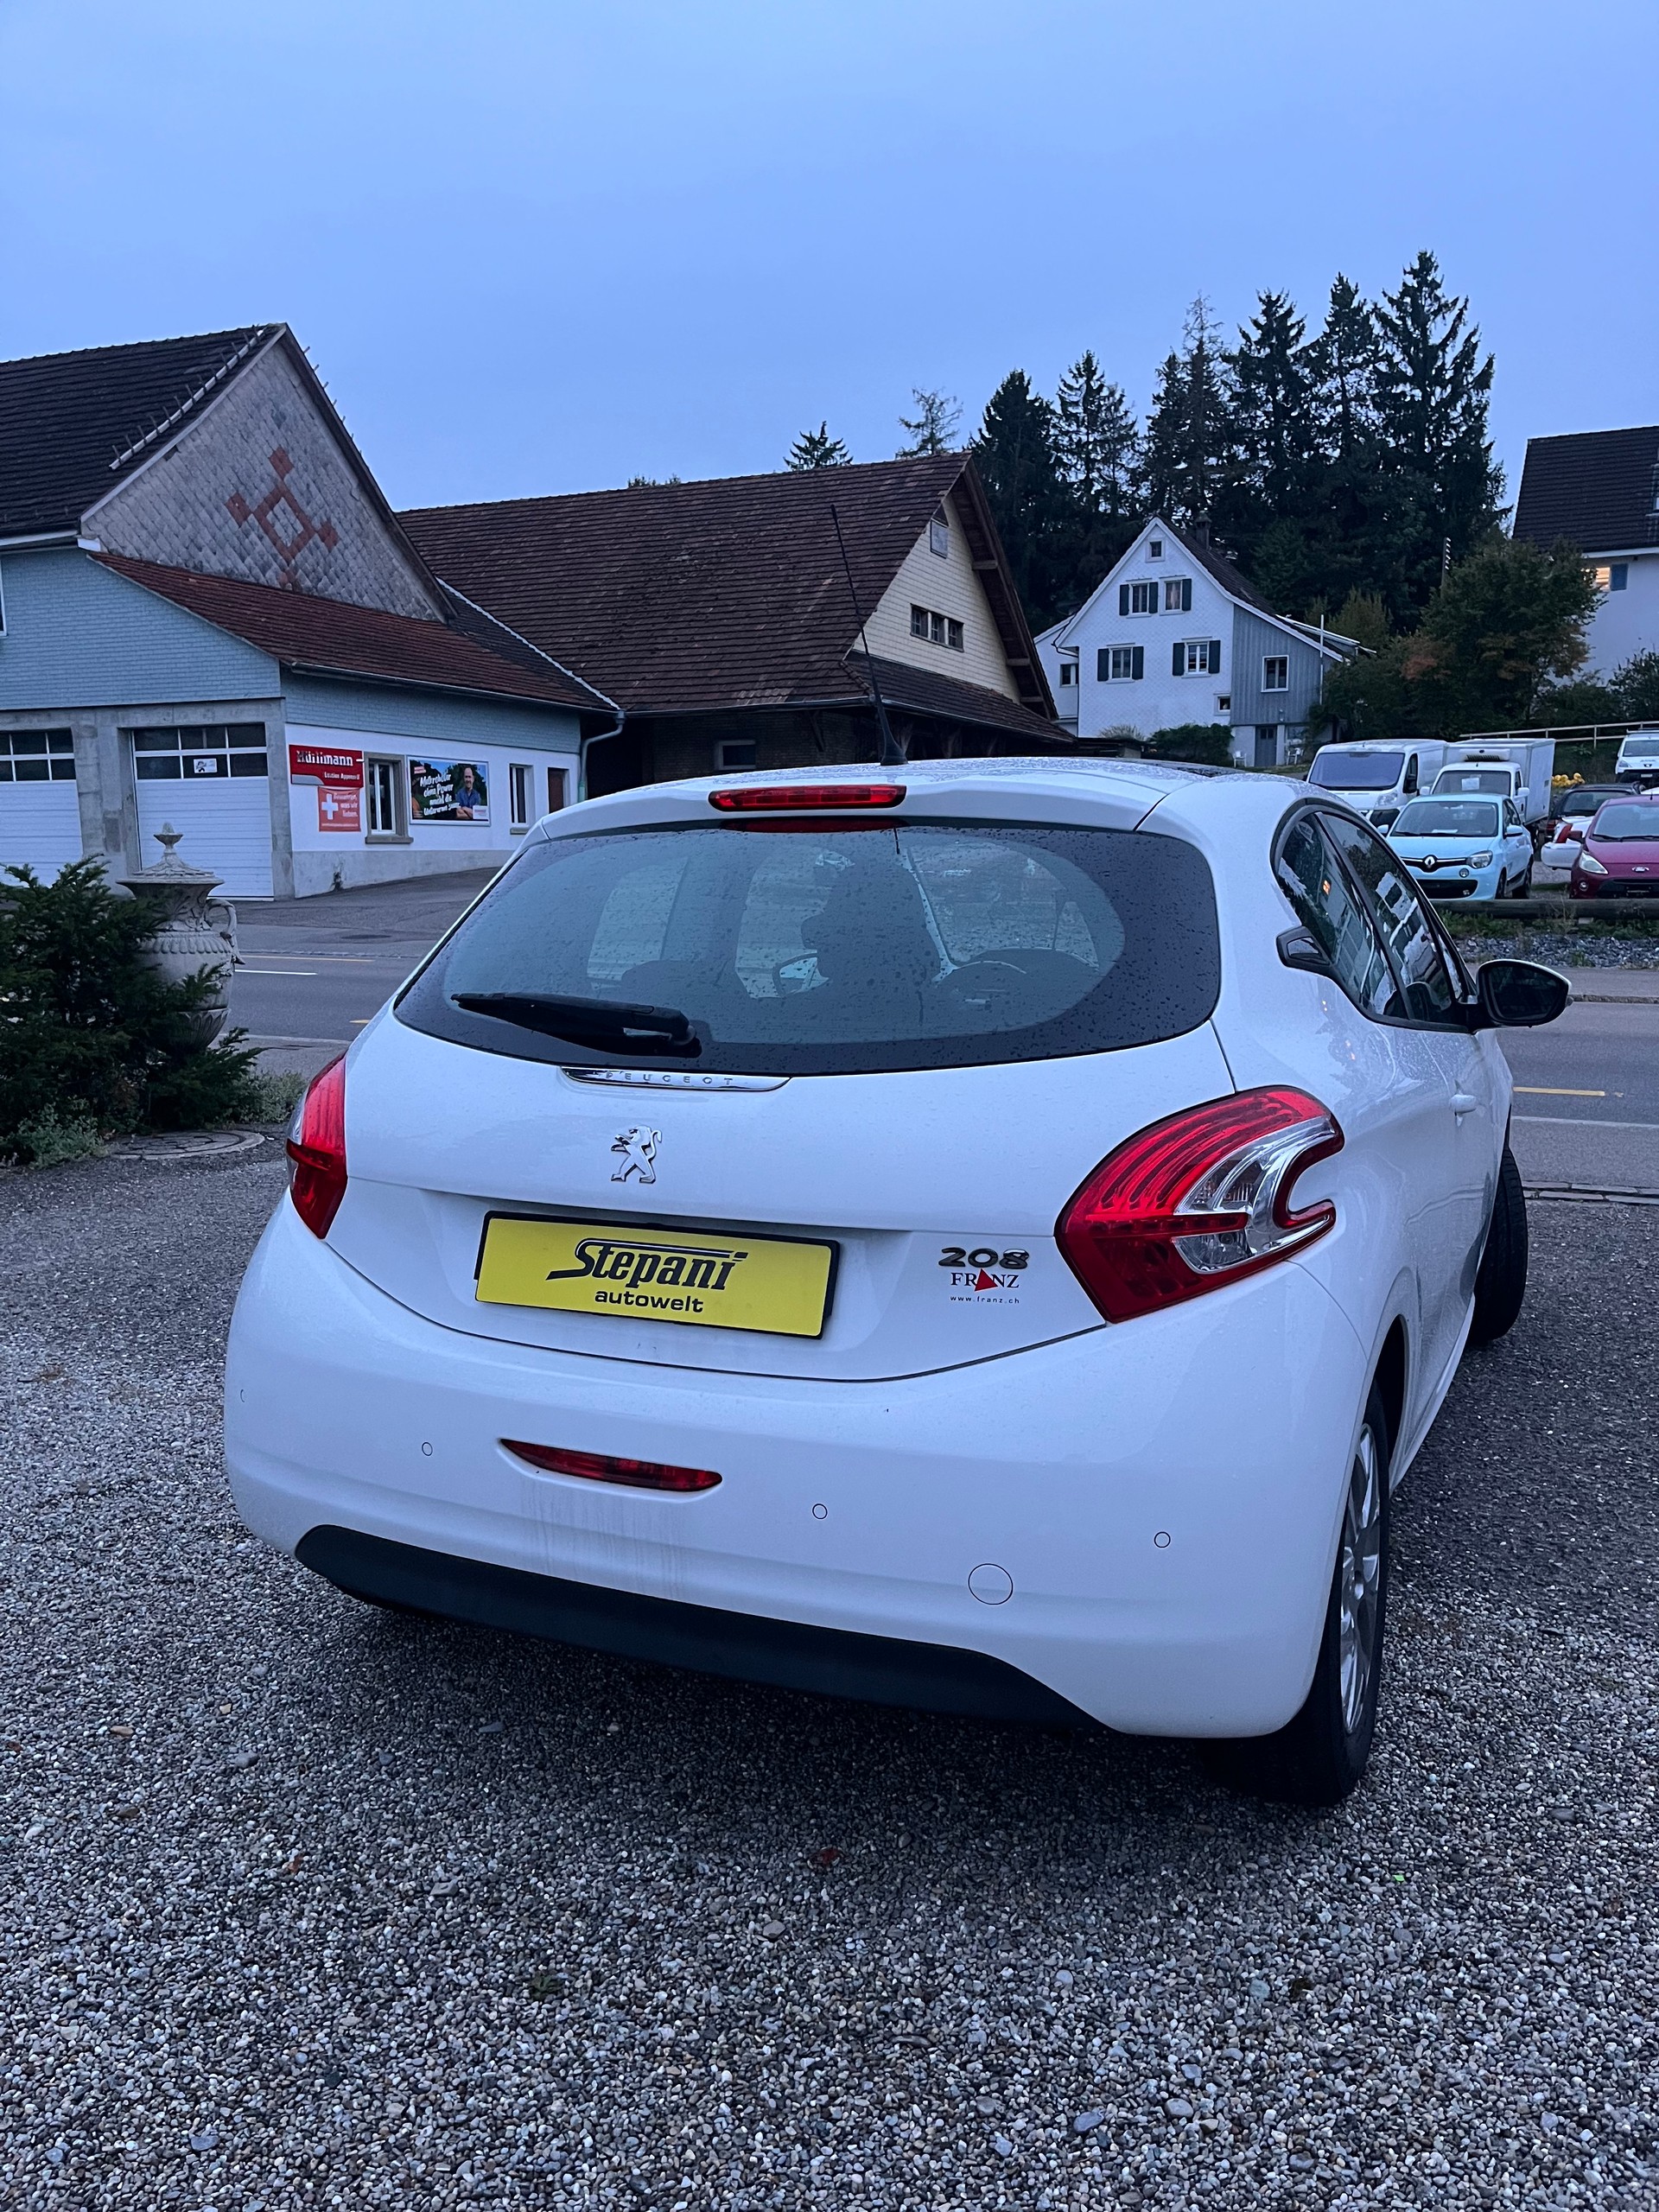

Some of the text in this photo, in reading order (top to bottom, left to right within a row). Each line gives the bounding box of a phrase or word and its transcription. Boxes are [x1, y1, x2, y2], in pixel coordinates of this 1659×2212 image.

[605, 1071, 734, 1086] PEUGEOT
[545, 1237, 749, 1291] Stepani
[938, 1247, 1030, 1269] 208
[594, 1291, 704, 1313] autowelt
